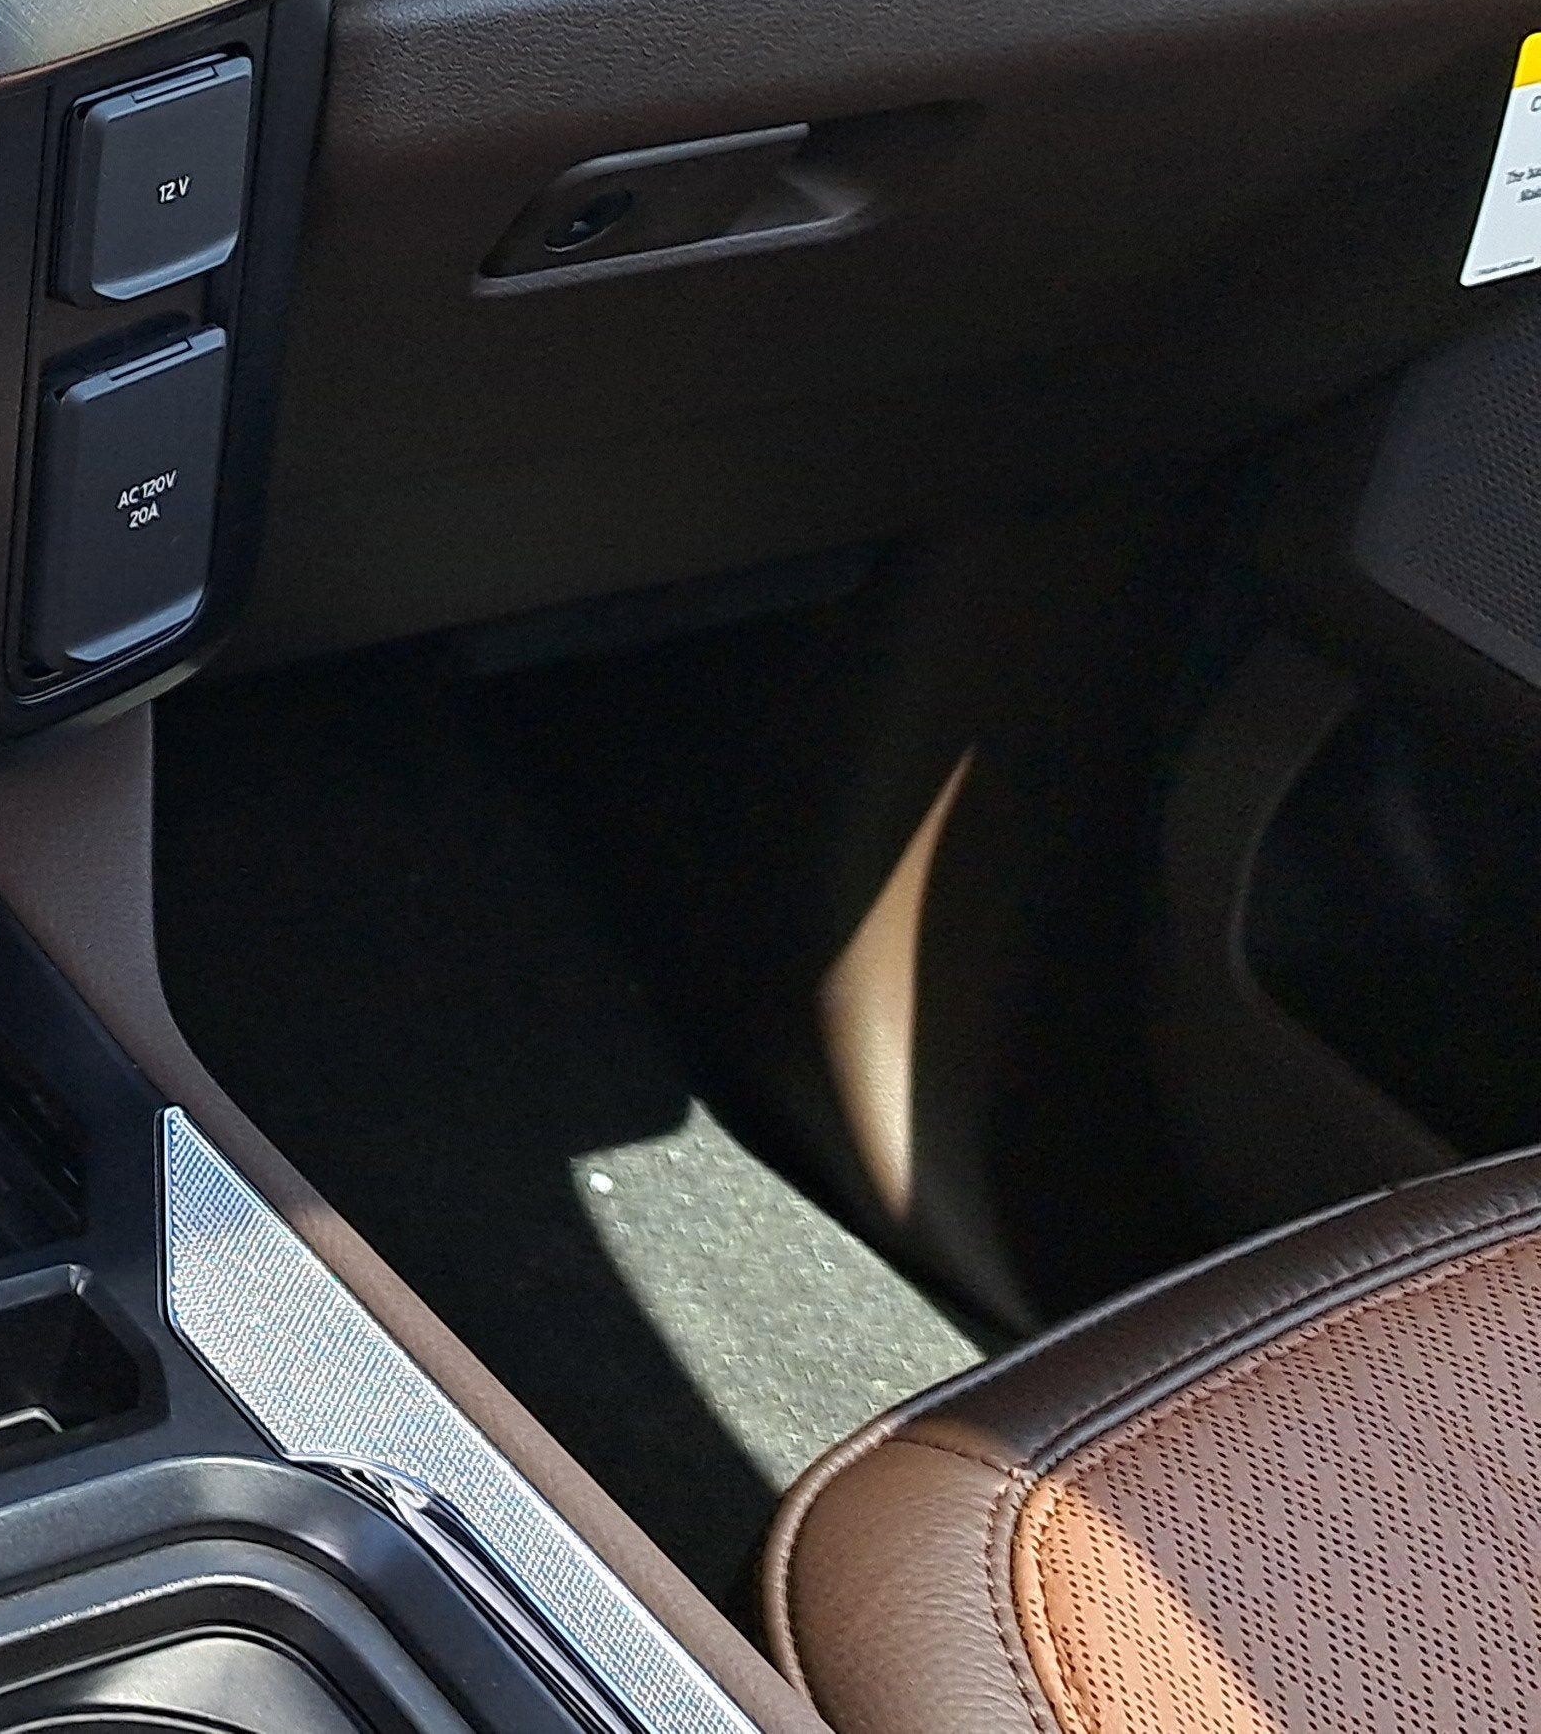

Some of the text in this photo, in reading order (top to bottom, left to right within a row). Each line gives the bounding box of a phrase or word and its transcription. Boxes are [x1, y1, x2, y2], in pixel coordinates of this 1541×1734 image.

[117, 469, 177, 510] AC 120V
[128, 500, 161, 529] 20A
